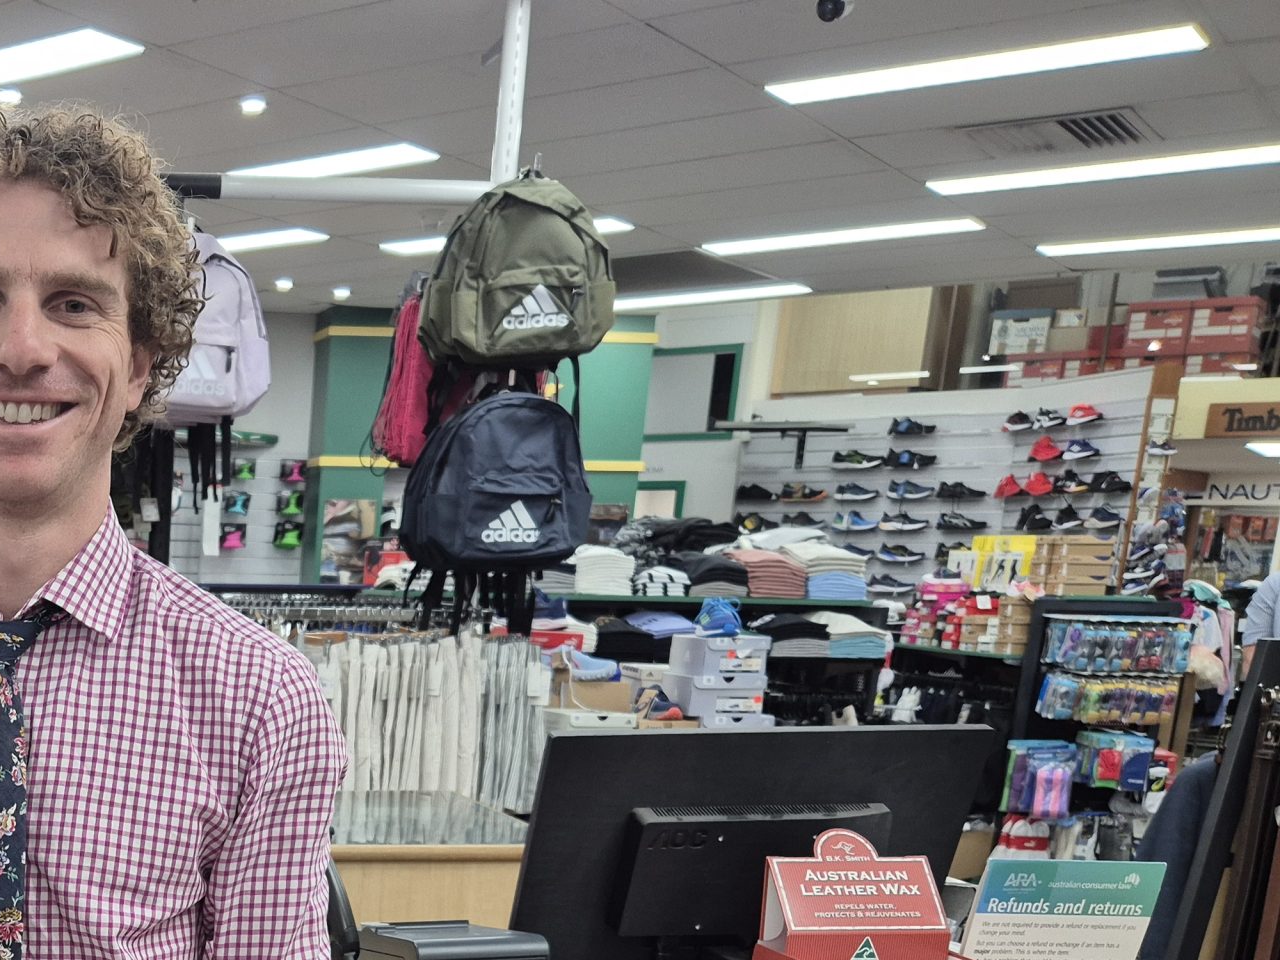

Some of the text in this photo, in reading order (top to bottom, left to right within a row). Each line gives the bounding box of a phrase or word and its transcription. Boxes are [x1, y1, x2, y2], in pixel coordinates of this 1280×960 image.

[502, 312, 569, 330] adidas
[805, 869, 908, 881] AUSTRALIAN
[1003, 872, 1037, 887] ARA
[800, 883, 920, 896] LEATHER WAX
[987, 897, 1143, 916] Refunds and returns
